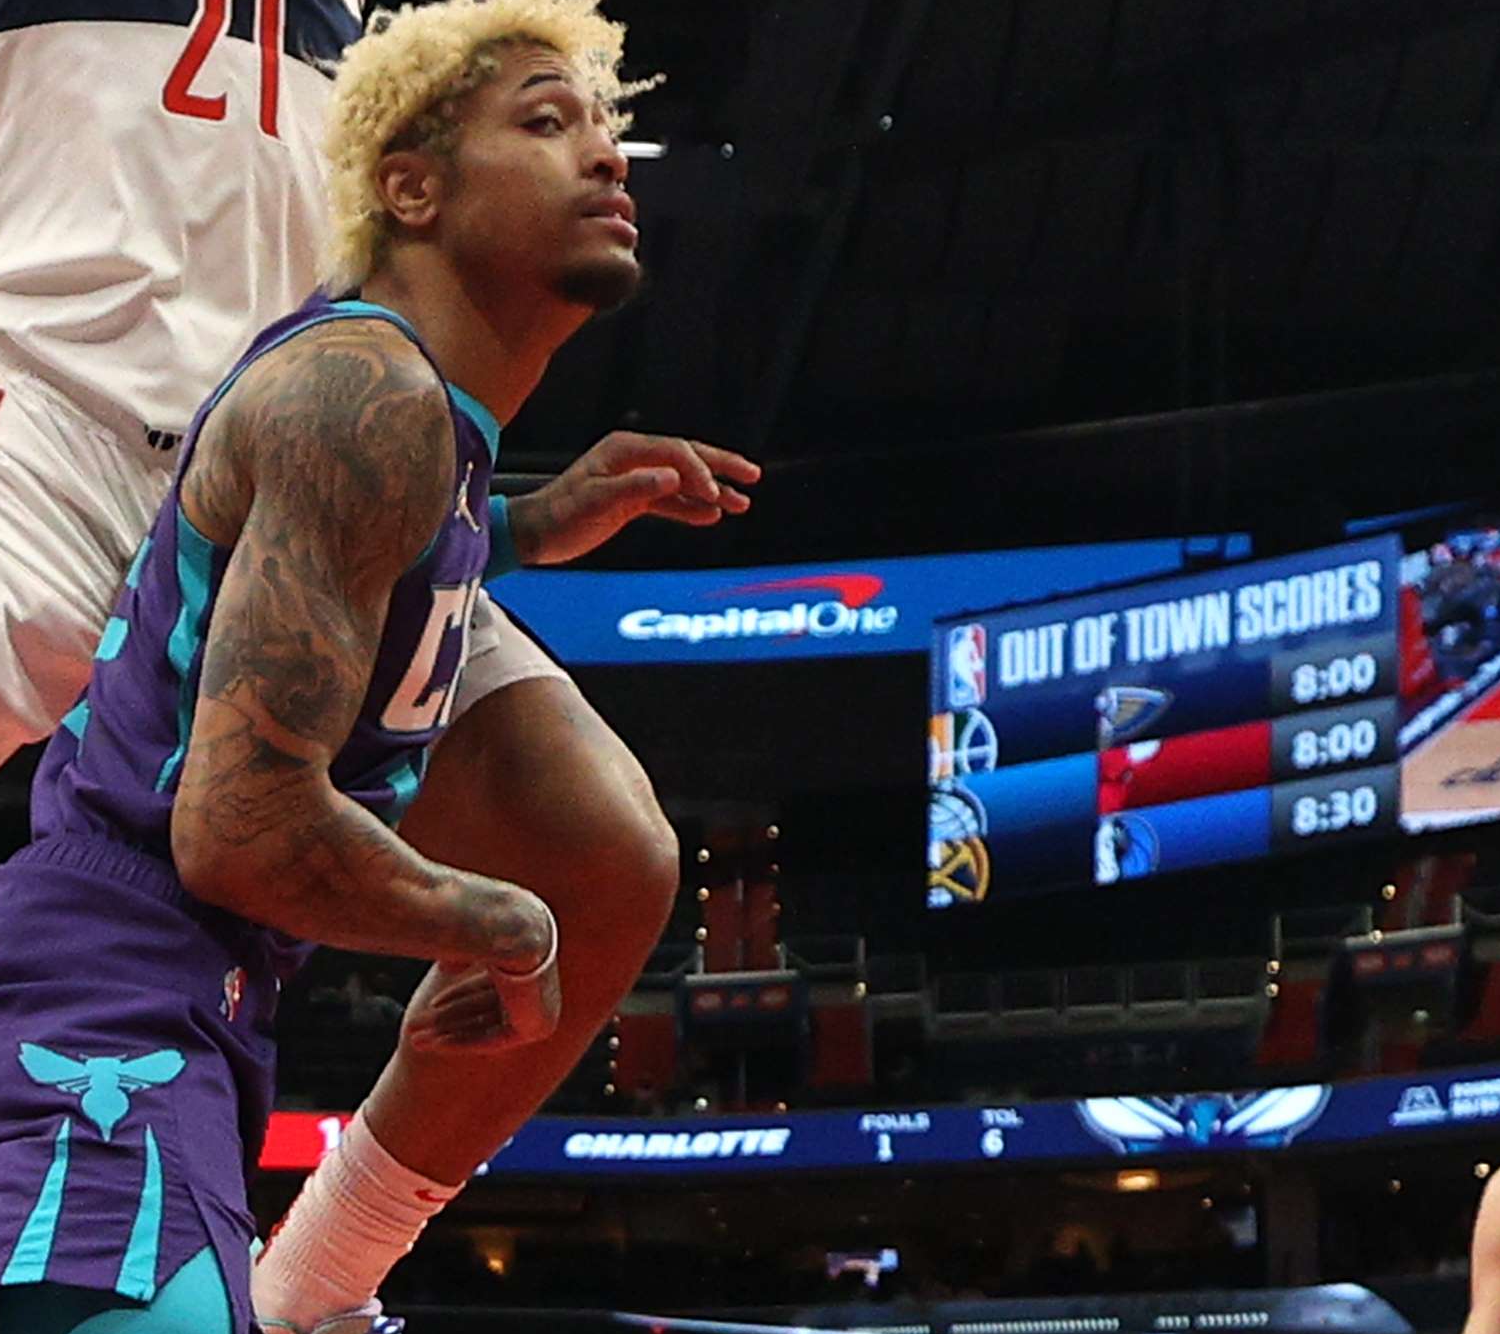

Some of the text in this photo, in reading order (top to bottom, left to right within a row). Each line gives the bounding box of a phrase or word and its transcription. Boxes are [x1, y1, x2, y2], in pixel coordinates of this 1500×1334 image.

[998, 559, 1383, 687] OUT OF TOWN SCORES
[1291, 653, 1377, 704] 8:00
[1291, 719, 1377, 769] 8:00
[1292, 786, 1378, 836] 8:30
[563, 1127, 792, 1161] CHARLOTTE
[859, 1111, 931, 1133] FOULS
[980, 1128, 1005, 1159] 6
